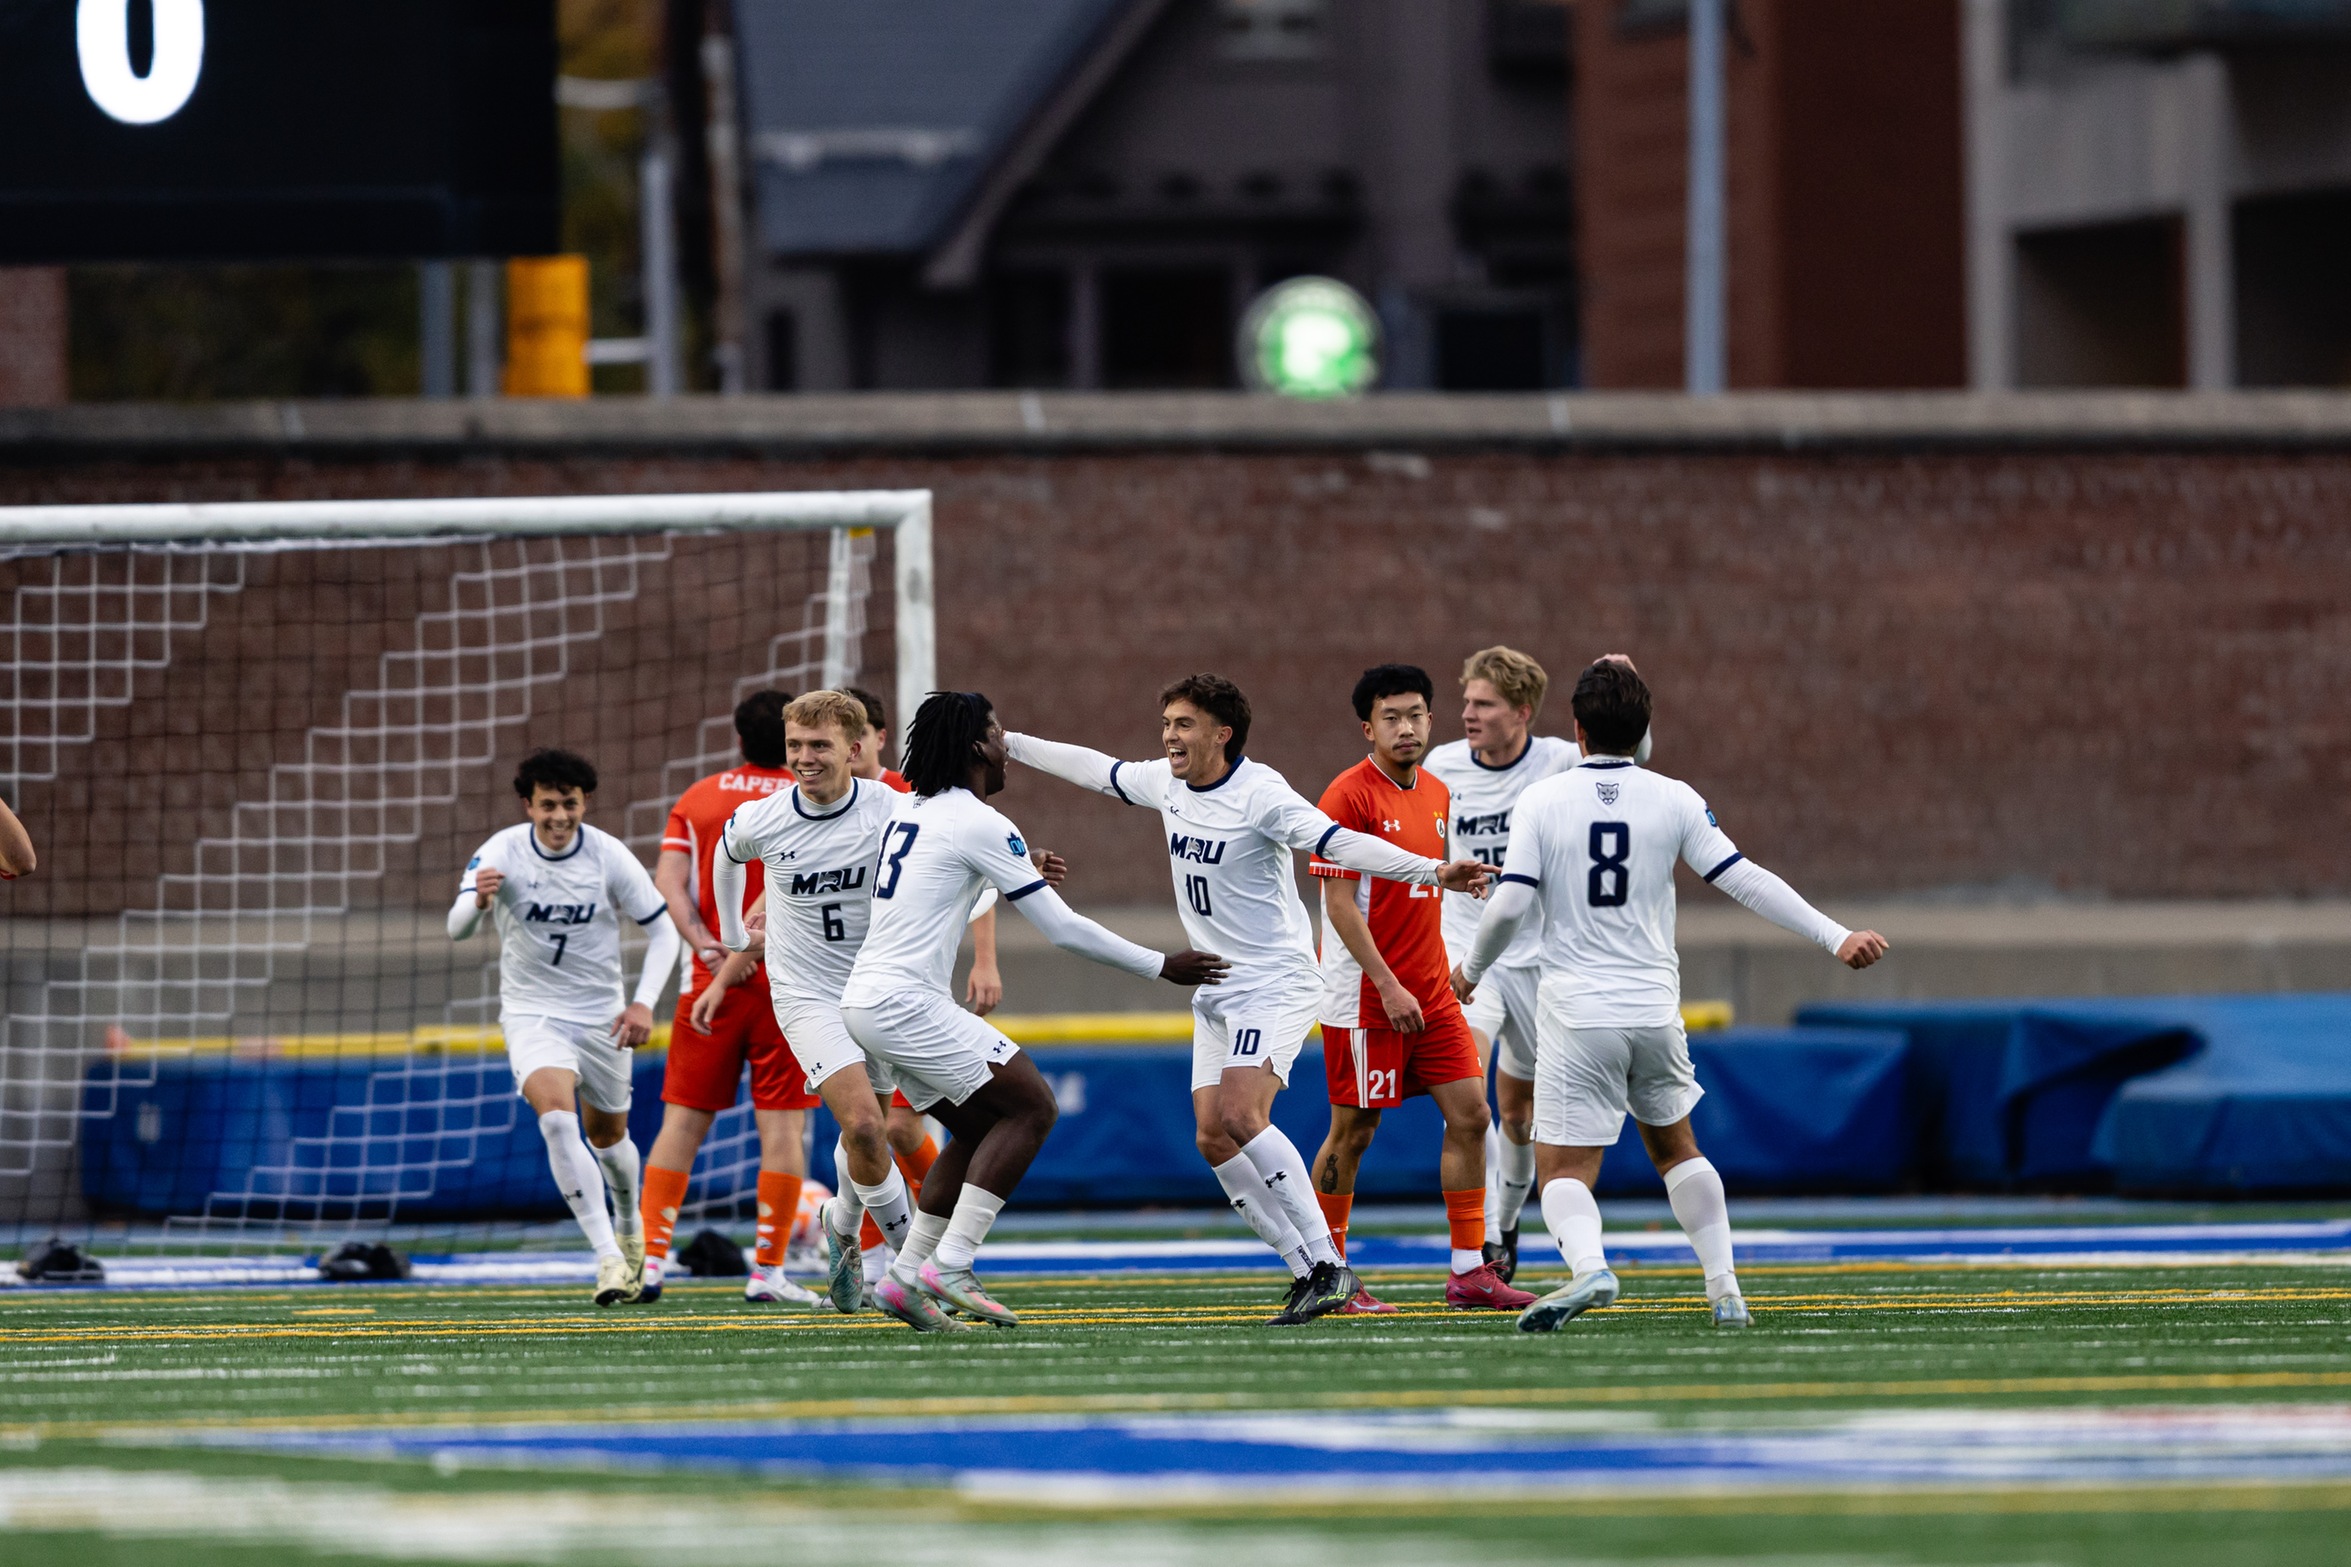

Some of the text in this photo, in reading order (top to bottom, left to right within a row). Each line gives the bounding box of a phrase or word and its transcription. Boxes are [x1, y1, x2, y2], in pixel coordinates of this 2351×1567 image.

[77, 0, 204, 124] 0
[719, 773, 797, 794] CAPER
[872, 821, 919, 899] 13
[1171, 832, 1227, 865] MRU
[1588, 822, 1630, 907] 8
[791, 866, 866, 895] MRU
[1186, 873, 1212, 916] 10
[526, 903, 596, 925] MRU
[822, 903, 845, 942] 6
[549, 933, 567, 966] 7
[1233, 1028, 1261, 1056] 10
[1368, 1068, 1396, 1100] 21
